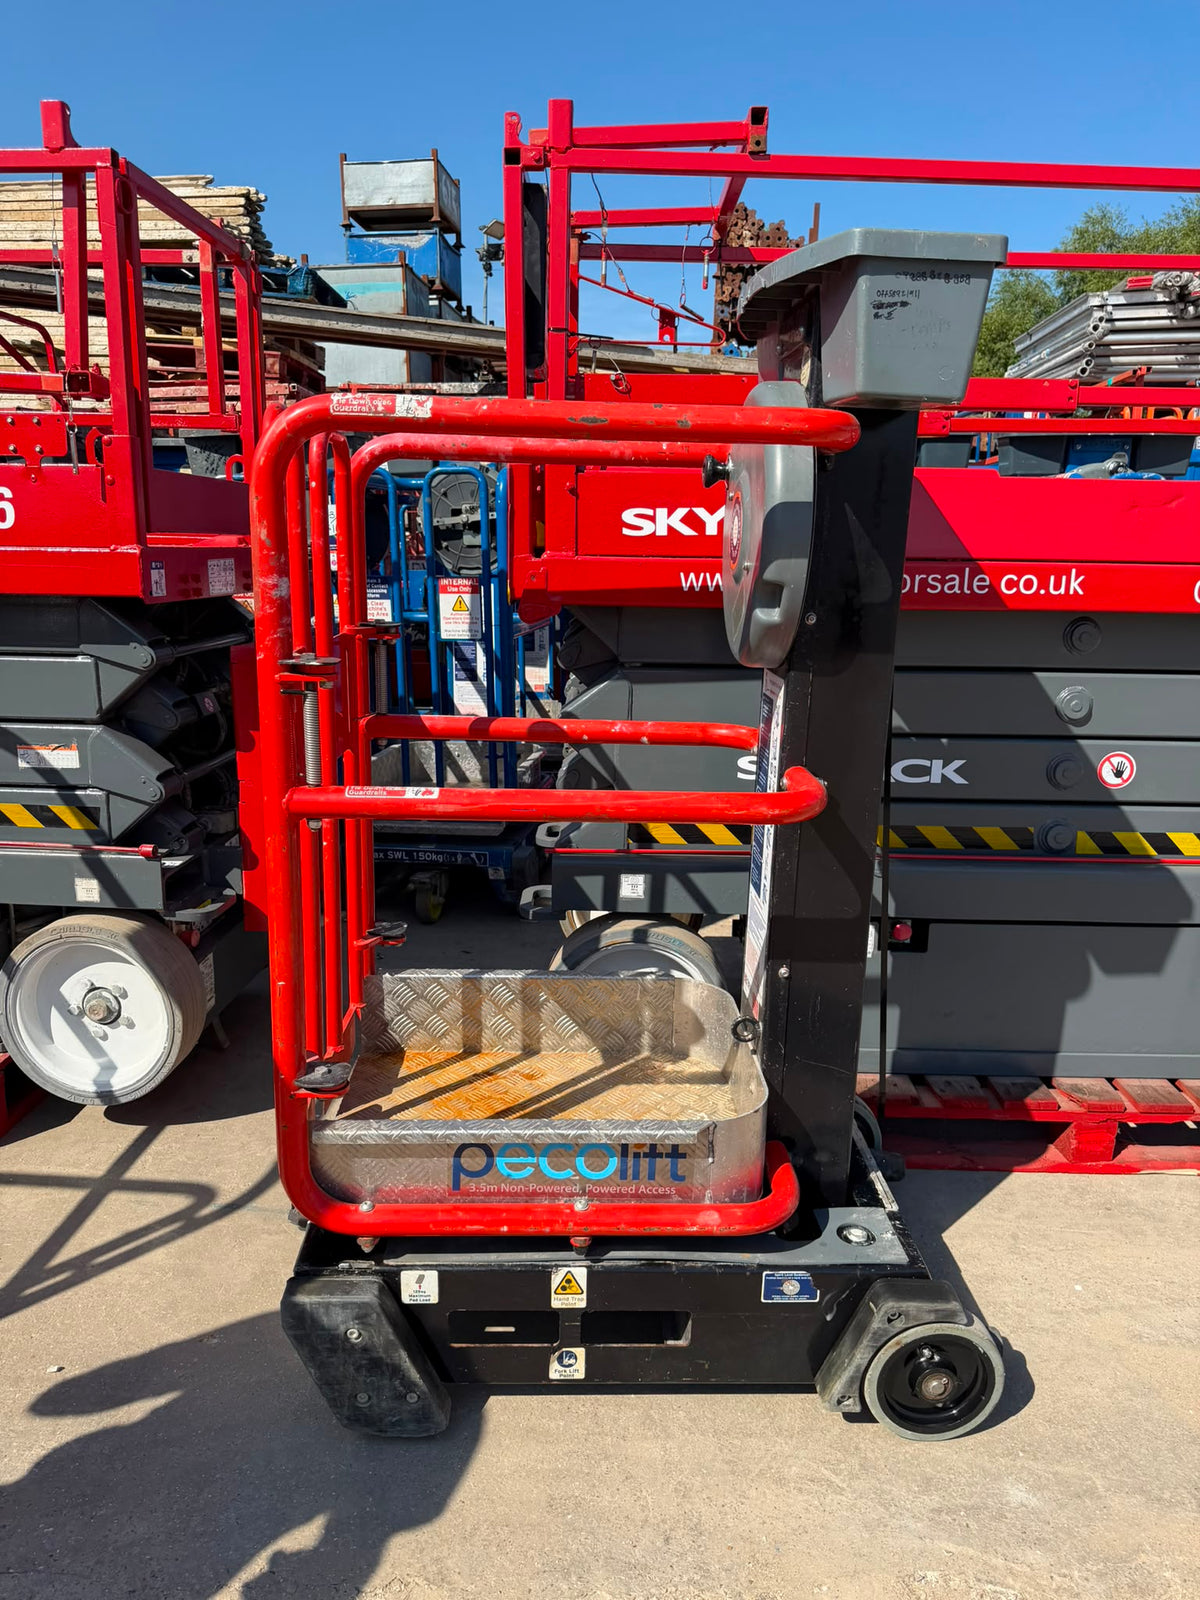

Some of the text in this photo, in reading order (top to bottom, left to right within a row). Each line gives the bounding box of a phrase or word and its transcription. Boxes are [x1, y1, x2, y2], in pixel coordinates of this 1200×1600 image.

[621, 505, 726, 536] SKY
[440, 578, 479, 586] INTERNAL
[1000, 568, 1085, 595] co.uk
[891, 758, 969, 784] CK
[387, 851, 409, 860] SWL
[469, 1183, 676, 1195] 3.5m Non-Powered, Powered Access
